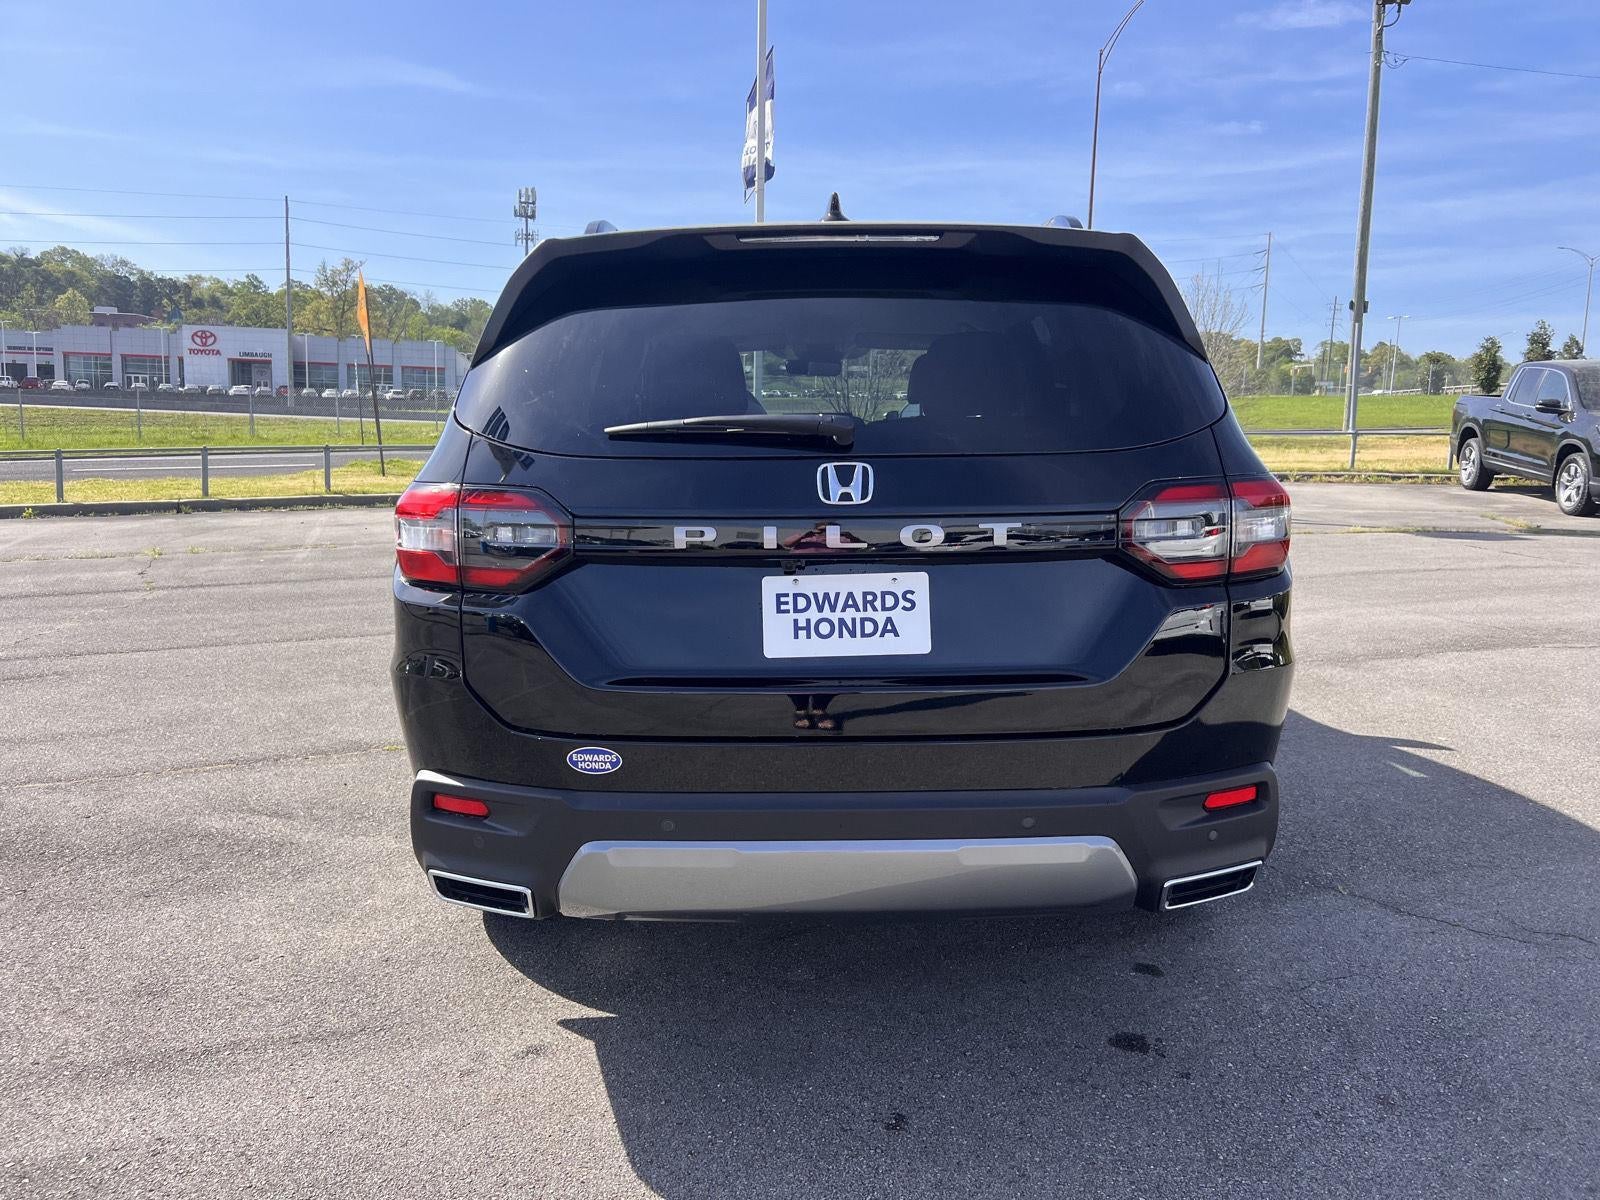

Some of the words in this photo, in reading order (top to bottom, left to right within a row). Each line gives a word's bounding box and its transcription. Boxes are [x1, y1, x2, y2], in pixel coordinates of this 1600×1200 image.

[188, 348, 222, 356] TOYOTA
[673, 523, 1023, 549] PILOT
[775, 590, 917, 614] EDWARDS
[793, 617, 901, 640] HONDA
[572, 753, 618, 762] EDWARDS
[578, 761, 612, 770] HONDA
